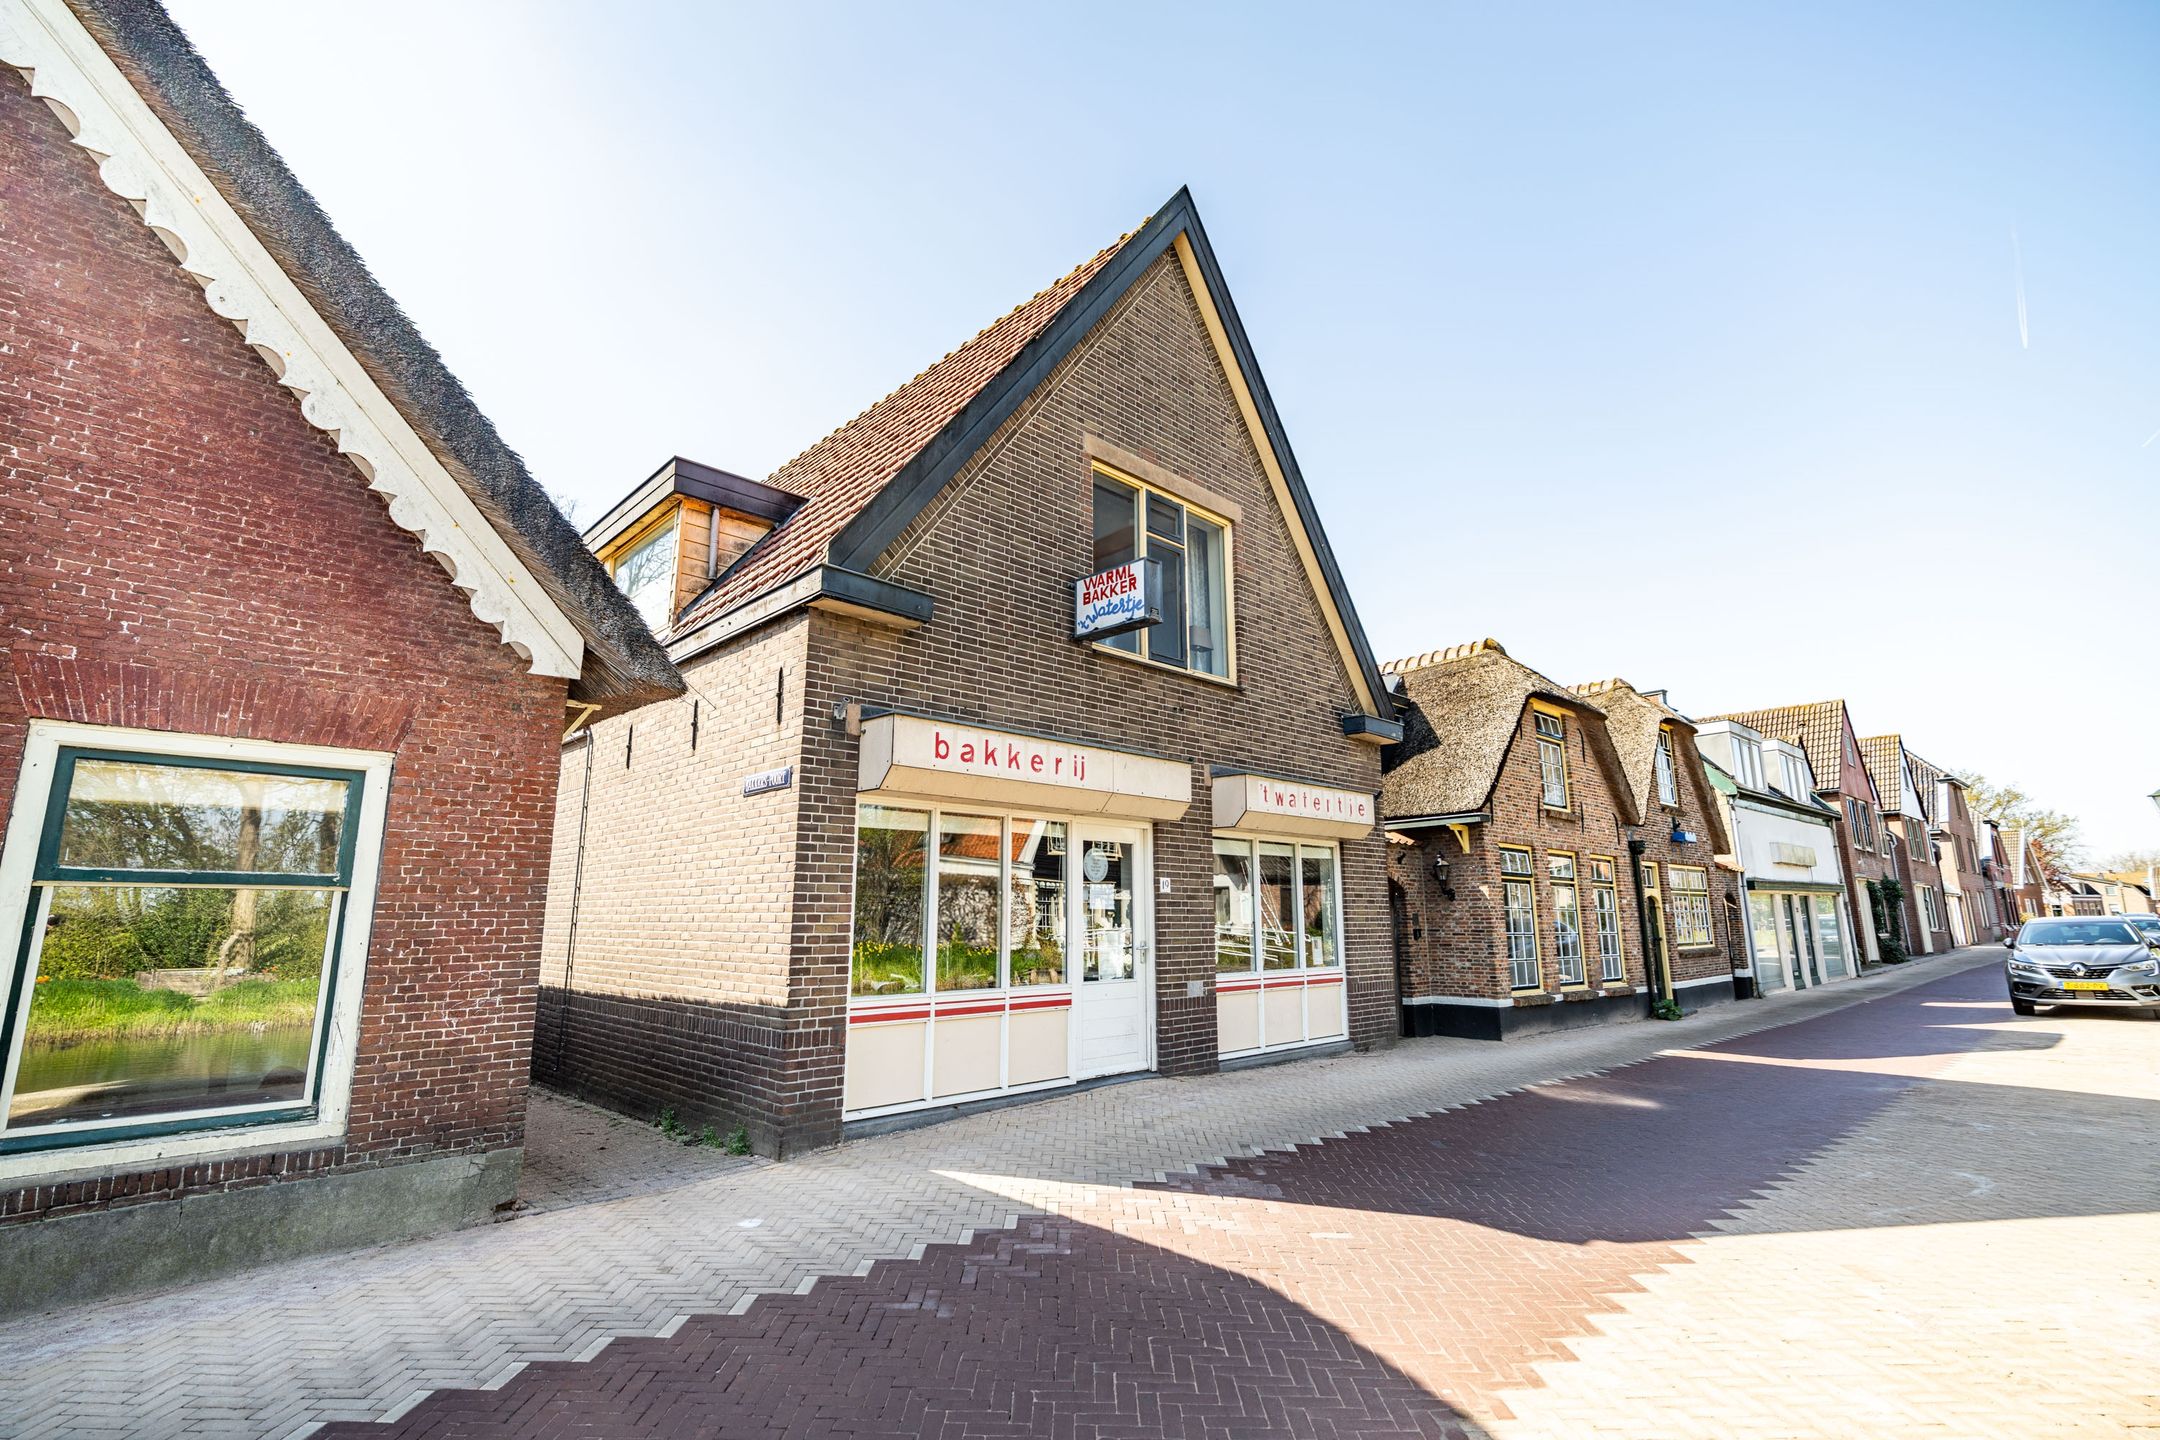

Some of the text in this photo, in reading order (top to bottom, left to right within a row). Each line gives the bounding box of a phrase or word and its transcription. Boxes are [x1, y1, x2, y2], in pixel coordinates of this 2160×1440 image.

[1083, 576, 1137, 606] BAKKER
[1085, 593, 1144, 624] Watertje
[934, 731, 1085, 781] bakkerij
[1161, 879, 1170, 891] 19
